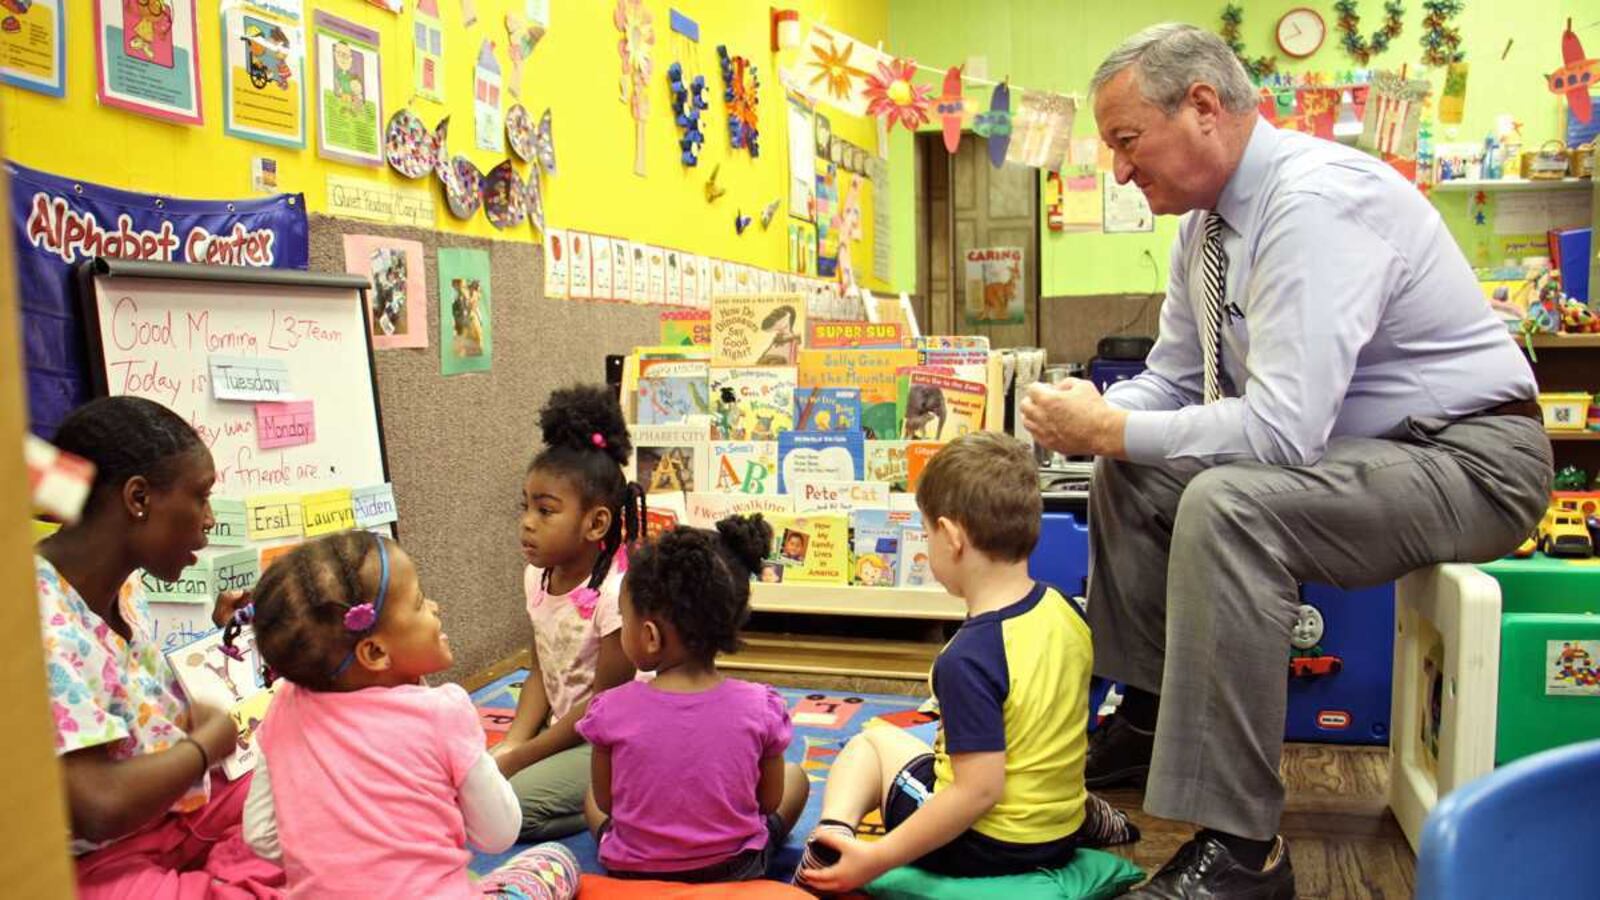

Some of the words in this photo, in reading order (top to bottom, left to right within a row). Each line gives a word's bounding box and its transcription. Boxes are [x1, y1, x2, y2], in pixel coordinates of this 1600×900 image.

[28, 192, 180, 264] Alphabet
[185, 221, 276, 267] Center
[967, 249, 1021, 262] CARING
[718, 306, 741, 319] How
[741, 304, 755, 319] Do
[112, 296, 177, 352] Good
[187, 308, 259, 360] Morning
[728, 326, 746, 338] Say
[722, 335, 749, 349] Good
[109, 360, 182, 402] Today
[216, 364, 281, 394] Tuesday
[263, 414, 309, 445] Monday
[805, 484, 838, 501] Pete
[254, 504, 291, 532] Ersil
[305, 505, 355, 528] Lauryn
[353, 494, 394, 520] Aiden
[217, 564, 255, 593] Star
